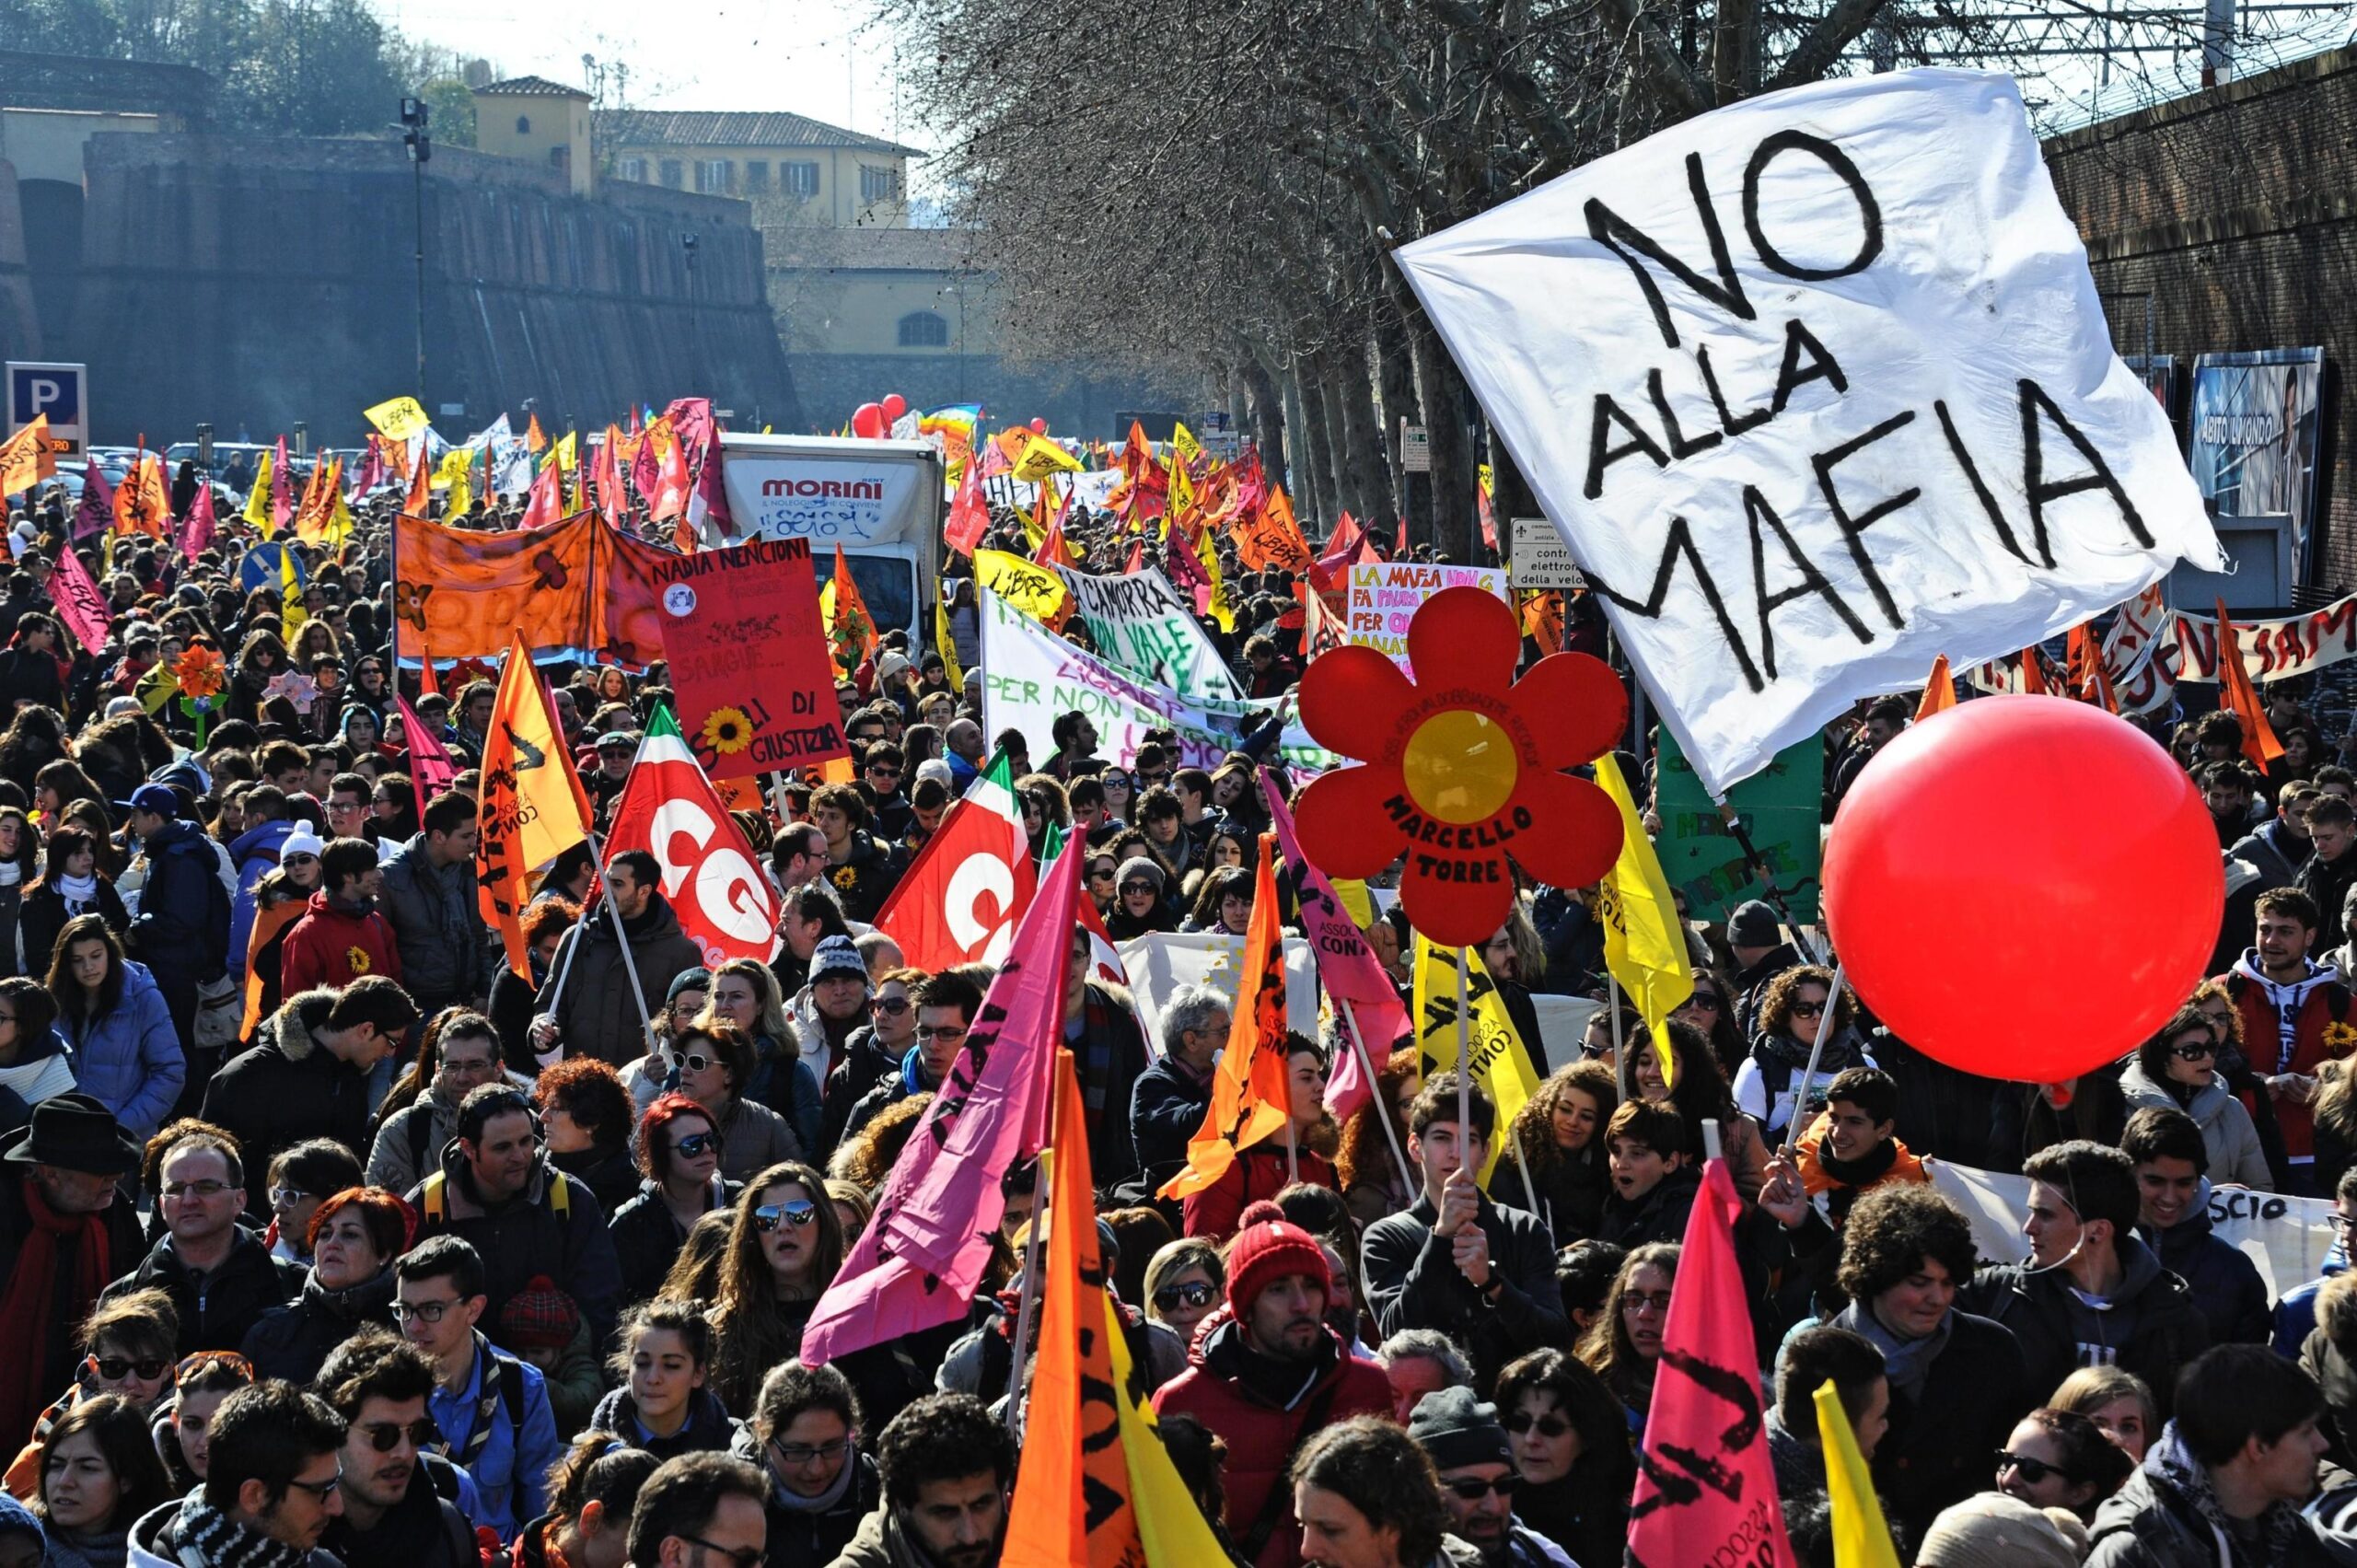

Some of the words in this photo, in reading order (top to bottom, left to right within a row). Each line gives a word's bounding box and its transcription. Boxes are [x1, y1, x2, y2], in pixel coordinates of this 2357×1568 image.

[1583, 130, 1884, 348] NO
[31, 379, 60, 413] P
[1583, 319, 1849, 500] ALLA
[2201, 415, 2228, 445] ABITO
[2236, 416, 2273, 445] MONDO
[762, 480, 882, 500] MORINI
[1576, 378, 2156, 694] MAFIA
[652, 554, 714, 585] NADIA
[718, 537, 810, 571] NENCIONI
[1354, 566, 1382, 587] LA
[1446, 569, 1479, 587] NON
[1520, 574, 1550, 584] della
[1082, 577, 1182, 624] CAMORRA
[1353, 588, 1372, 609] FA
[1376, 590, 1419, 609] PAURA
[1353, 612, 1382, 632] PER
[1124, 619, 1192, 665] VALE
[791, 691, 815, 715] DI
[985, 673, 1041, 705] PER
[1052, 684, 1121, 719] NON
[749, 722, 843, 764] GIUSTIZIA
[1383, 793, 1533, 853] MARCELLO
[1416, 853, 1501, 884] TORRE
